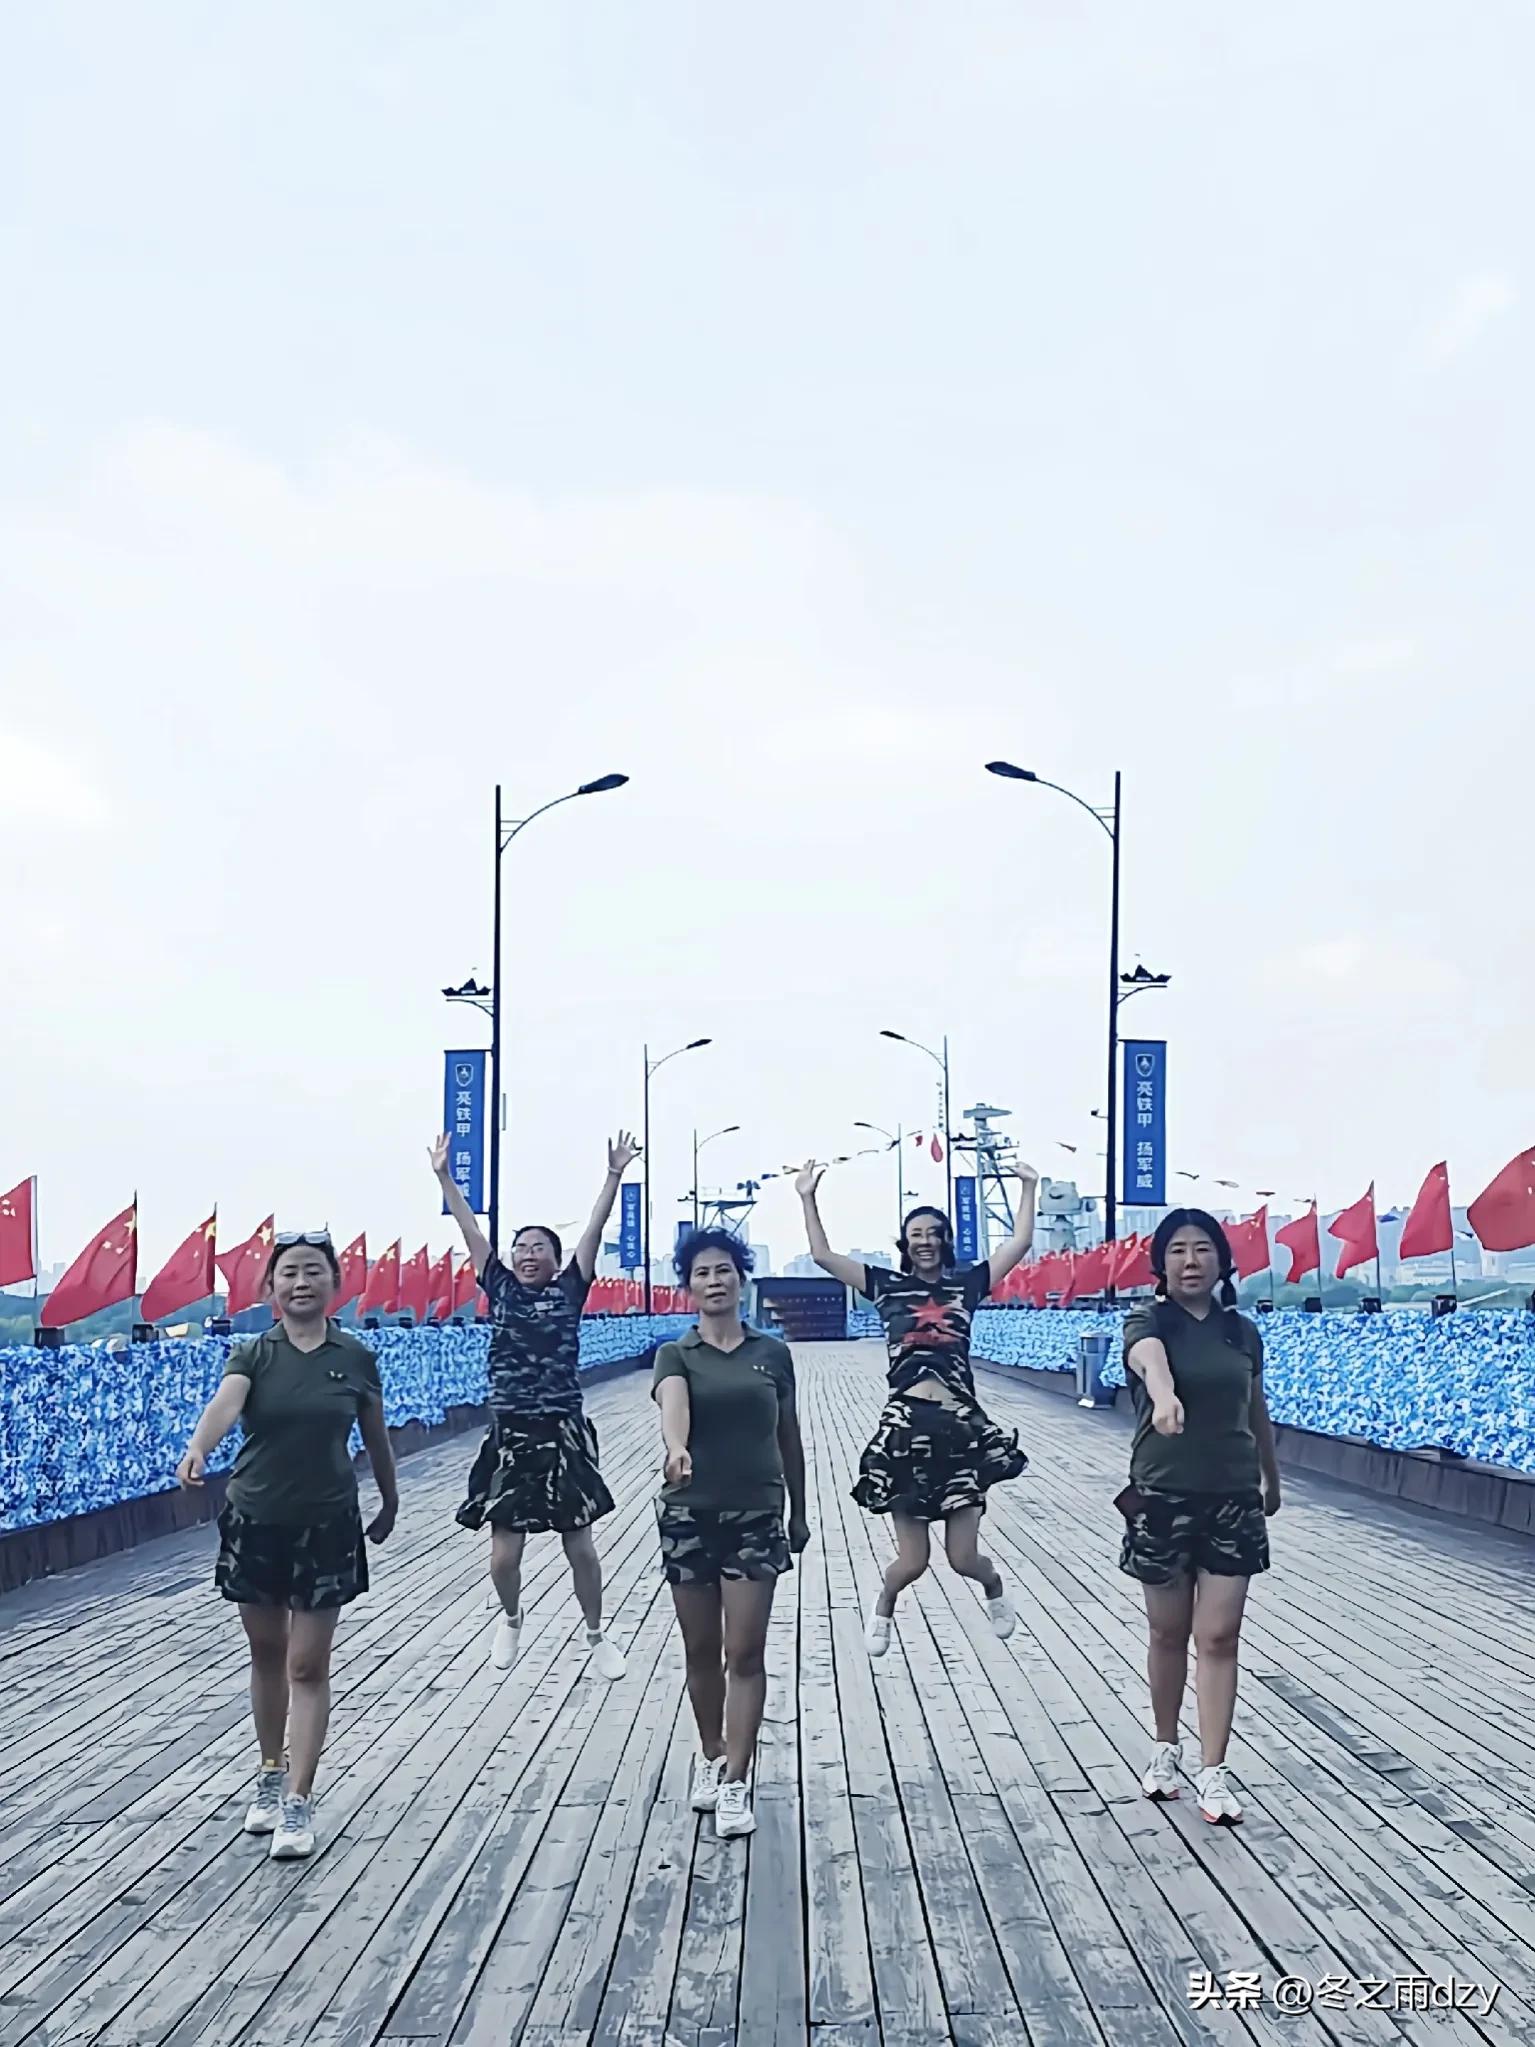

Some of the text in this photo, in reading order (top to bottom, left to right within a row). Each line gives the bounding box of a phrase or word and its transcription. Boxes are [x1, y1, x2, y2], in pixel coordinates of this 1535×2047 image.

[456, 1090, 472, 1138] 亮铁甲
[1136, 1080, 1153, 1188] 亮铁甲 扬军威
